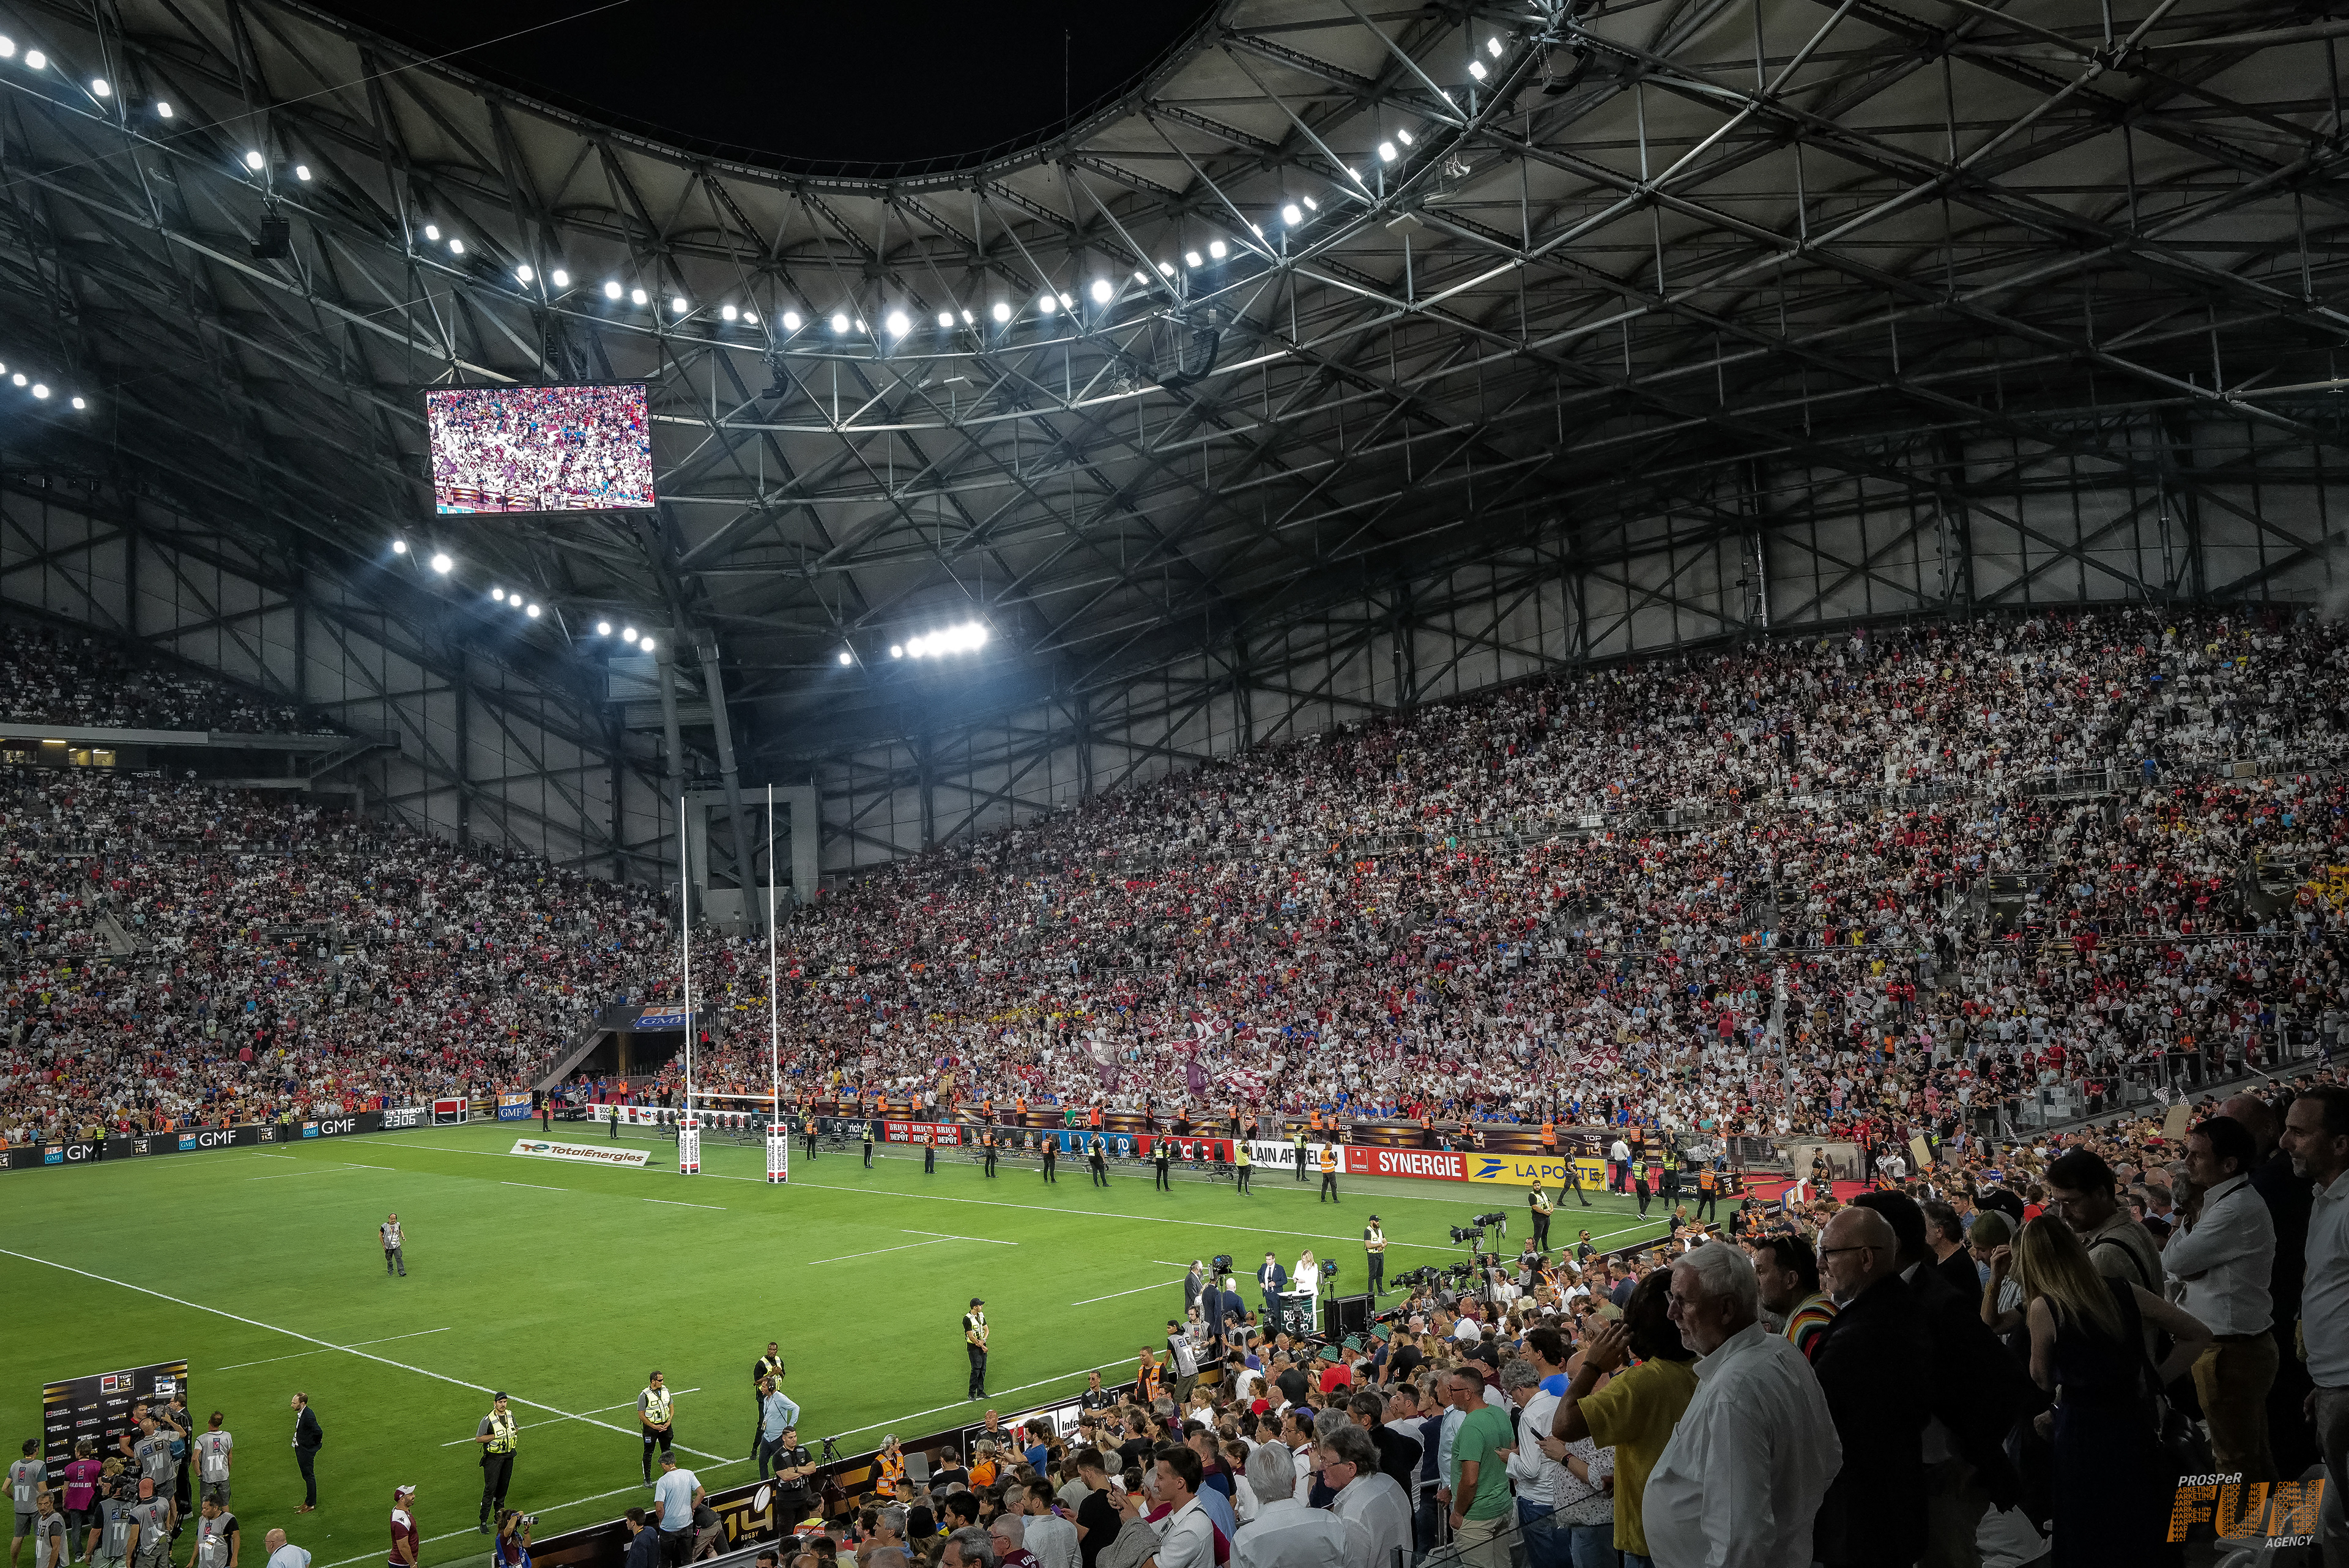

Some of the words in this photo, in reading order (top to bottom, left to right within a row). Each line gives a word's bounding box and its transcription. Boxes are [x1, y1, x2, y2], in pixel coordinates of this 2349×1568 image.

[397, 1107, 426, 1115] TISSOT
[501, 1108, 522, 1117] GMF
[322, 1118, 355, 1134] GMF
[199, 1130, 236, 1146] GMF
[890, 1131, 909, 1142] DEPÔT
[937, 1134, 958, 1145] DEPÔT
[1339, 1135, 1353, 1144] 14
[552, 1146, 644, 1162] TotalEnergies
[1250, 1146, 1276, 1162] LAIN
[1584, 1146, 1602, 1156] 14
[1378, 1151, 1463, 1178] SYNERGIE
[1515, 1164, 1538, 1178] LA
[1542, 1165, 1599, 1181] POTE
[1767, 1205, 1781, 1214] TISSOT
[1062, 1420, 1078, 1431] Inte
[147, 1453, 164, 1471] TV
[207, 1454, 225, 1472] TV
[15, 1485, 30, 1501] TV
[113, 1522, 128, 1540] TV
[724, 1503, 773, 1543] 14
[741, 1530, 759, 1541] RUGBY
[1020, 1555, 1036, 1566] UBB
